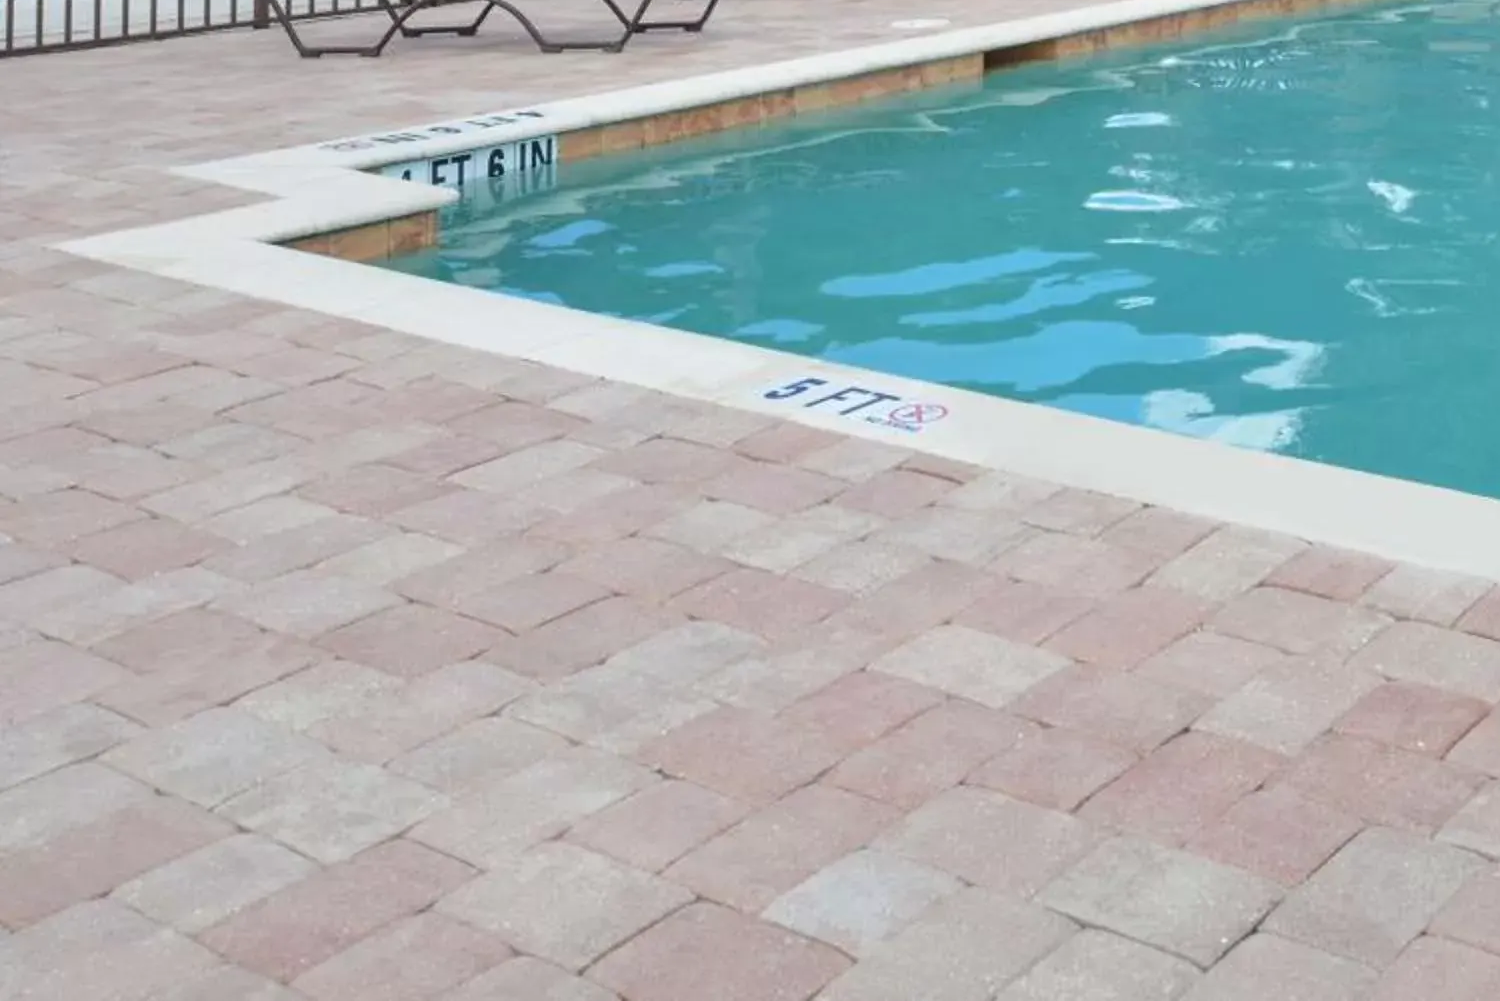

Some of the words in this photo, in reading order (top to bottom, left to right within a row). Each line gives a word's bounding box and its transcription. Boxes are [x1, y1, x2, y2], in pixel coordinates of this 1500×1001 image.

[431, 154, 472, 187] FT
[488, 149, 506, 178] 6
[519, 139, 554, 172] IN
[764, 377, 829, 400] 5
[804, 386, 902, 416] FT
